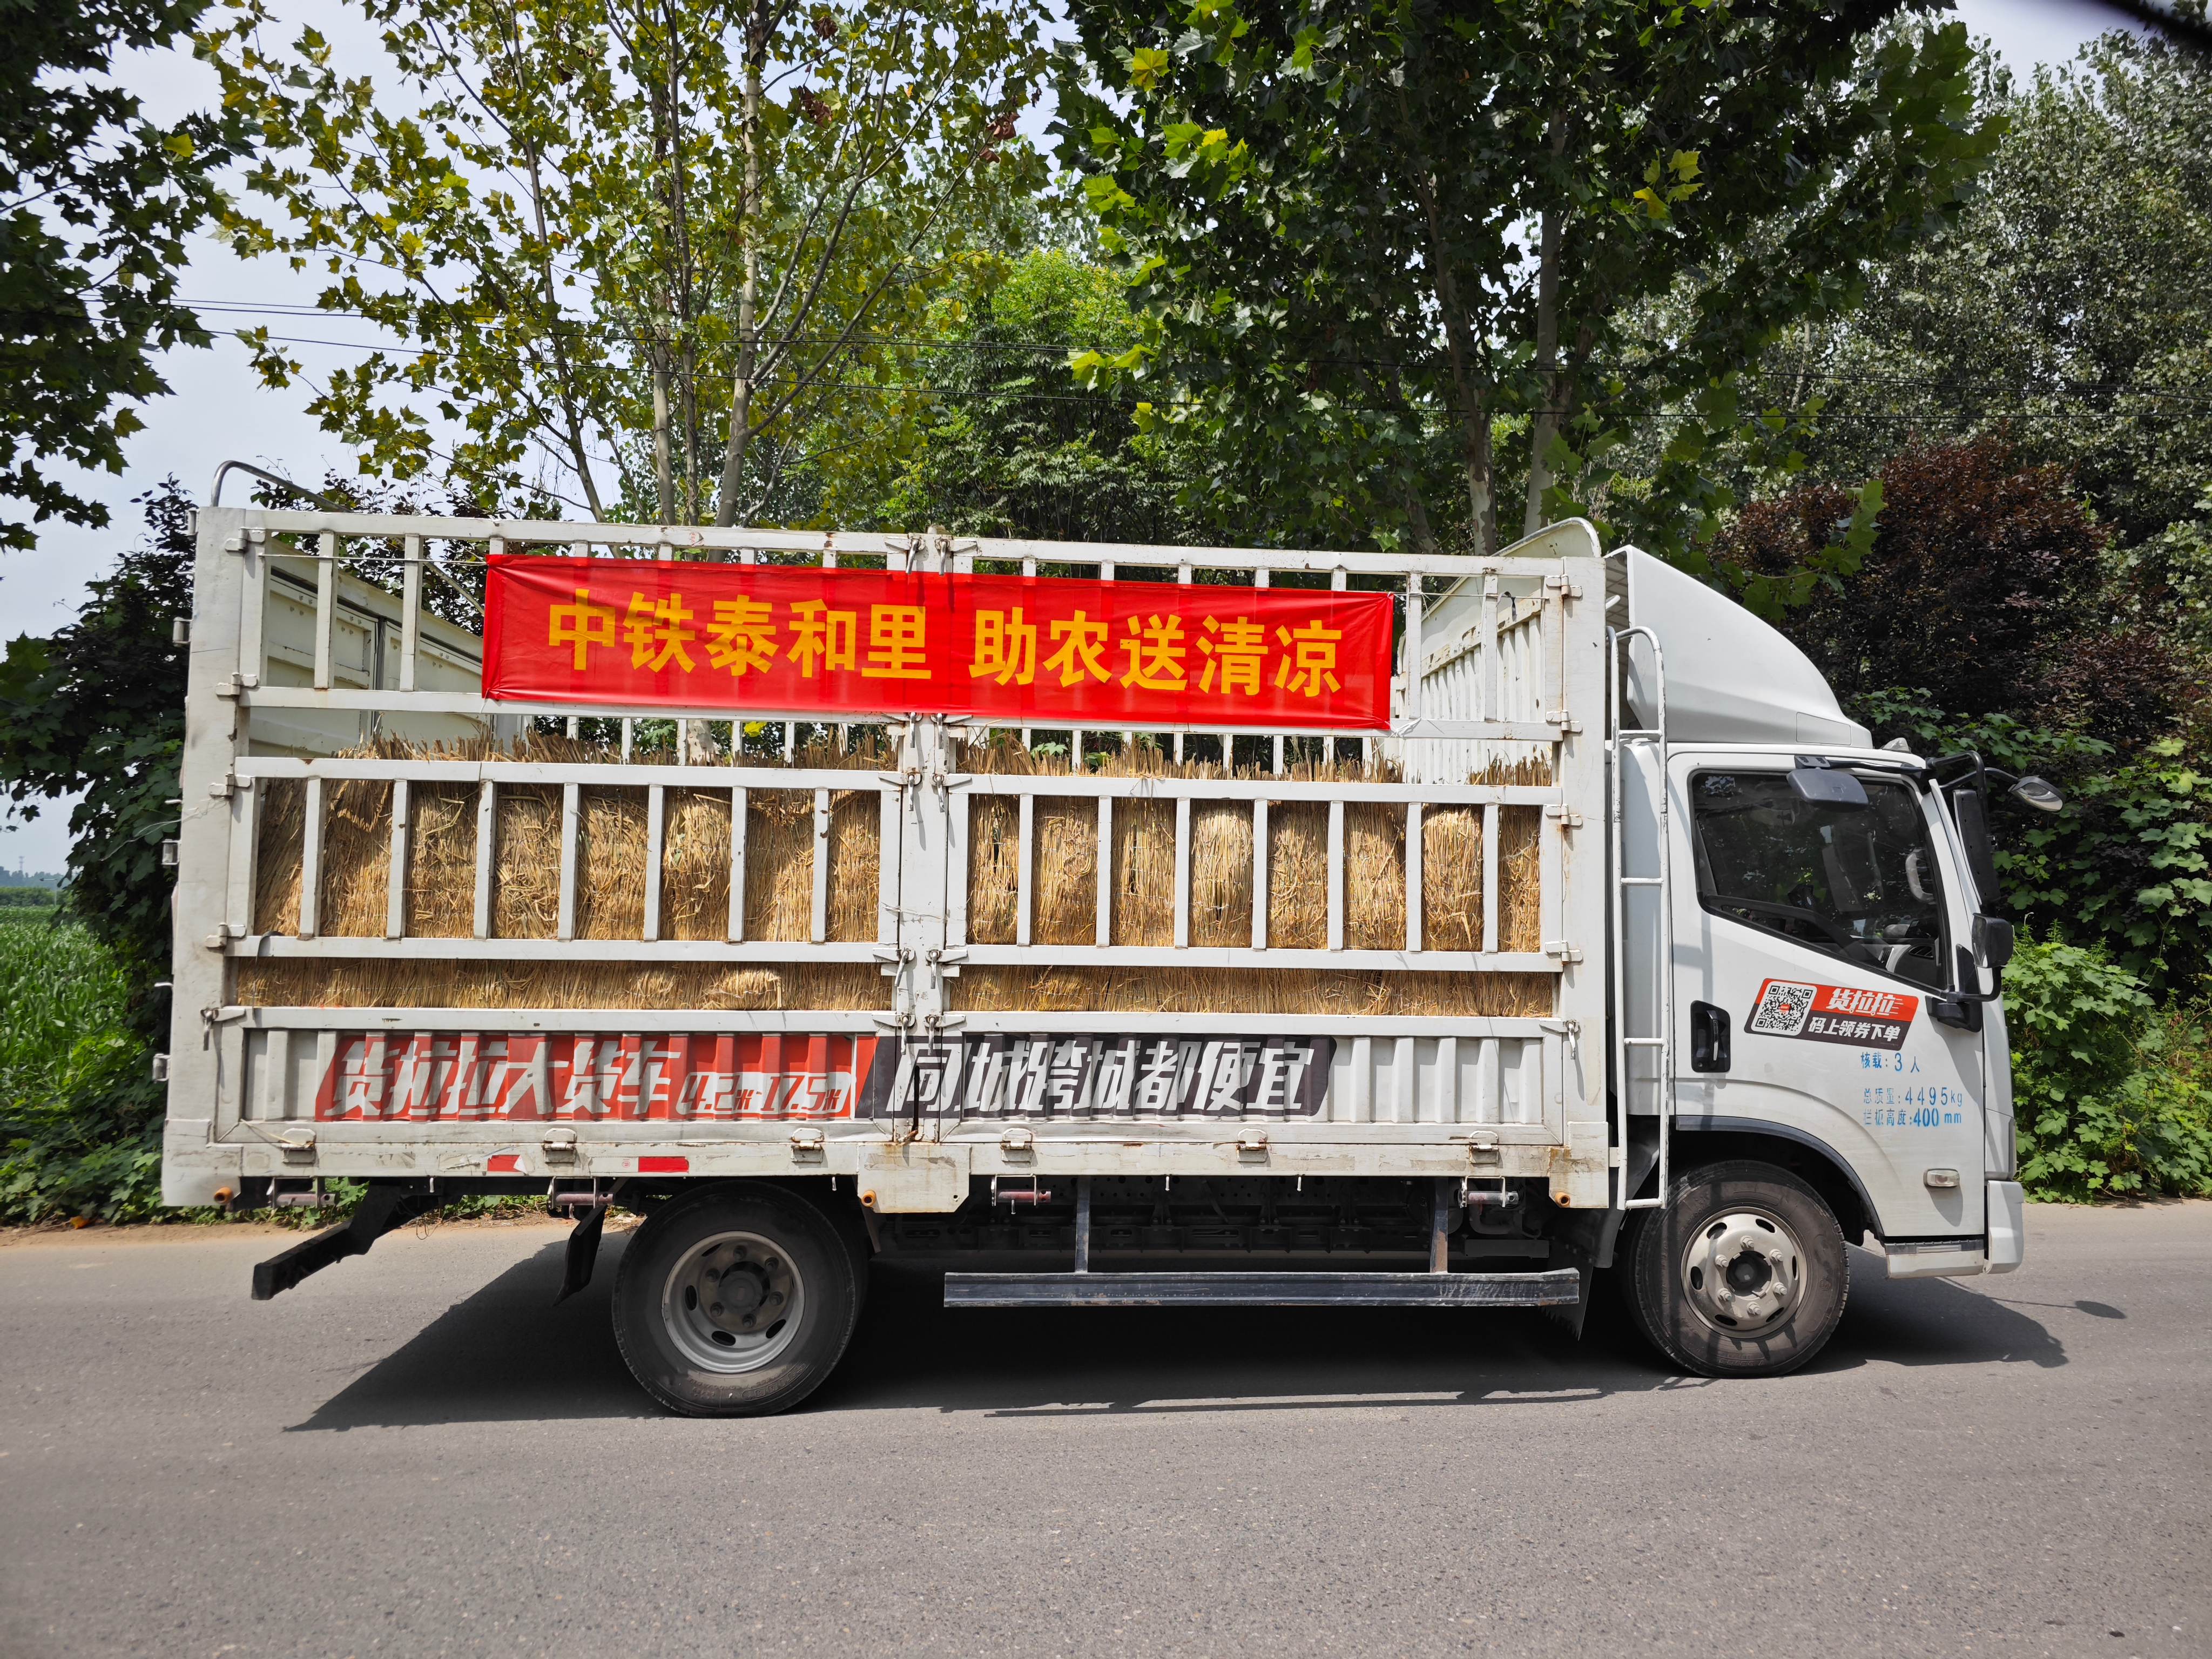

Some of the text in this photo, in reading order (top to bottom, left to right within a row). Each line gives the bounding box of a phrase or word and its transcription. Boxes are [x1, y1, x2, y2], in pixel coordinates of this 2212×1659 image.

[549, 589, 1342, 697] 中铁泰和里 助农送清凉
[1808, 1016, 1901, 1042] 码上领券下单
[1826, 987, 1898, 1016] 货拉拉
[324, 1040, 682, 1116] 货拉拉大货车
[886, 1040, 1314, 1112] 同城跨城都便宜
